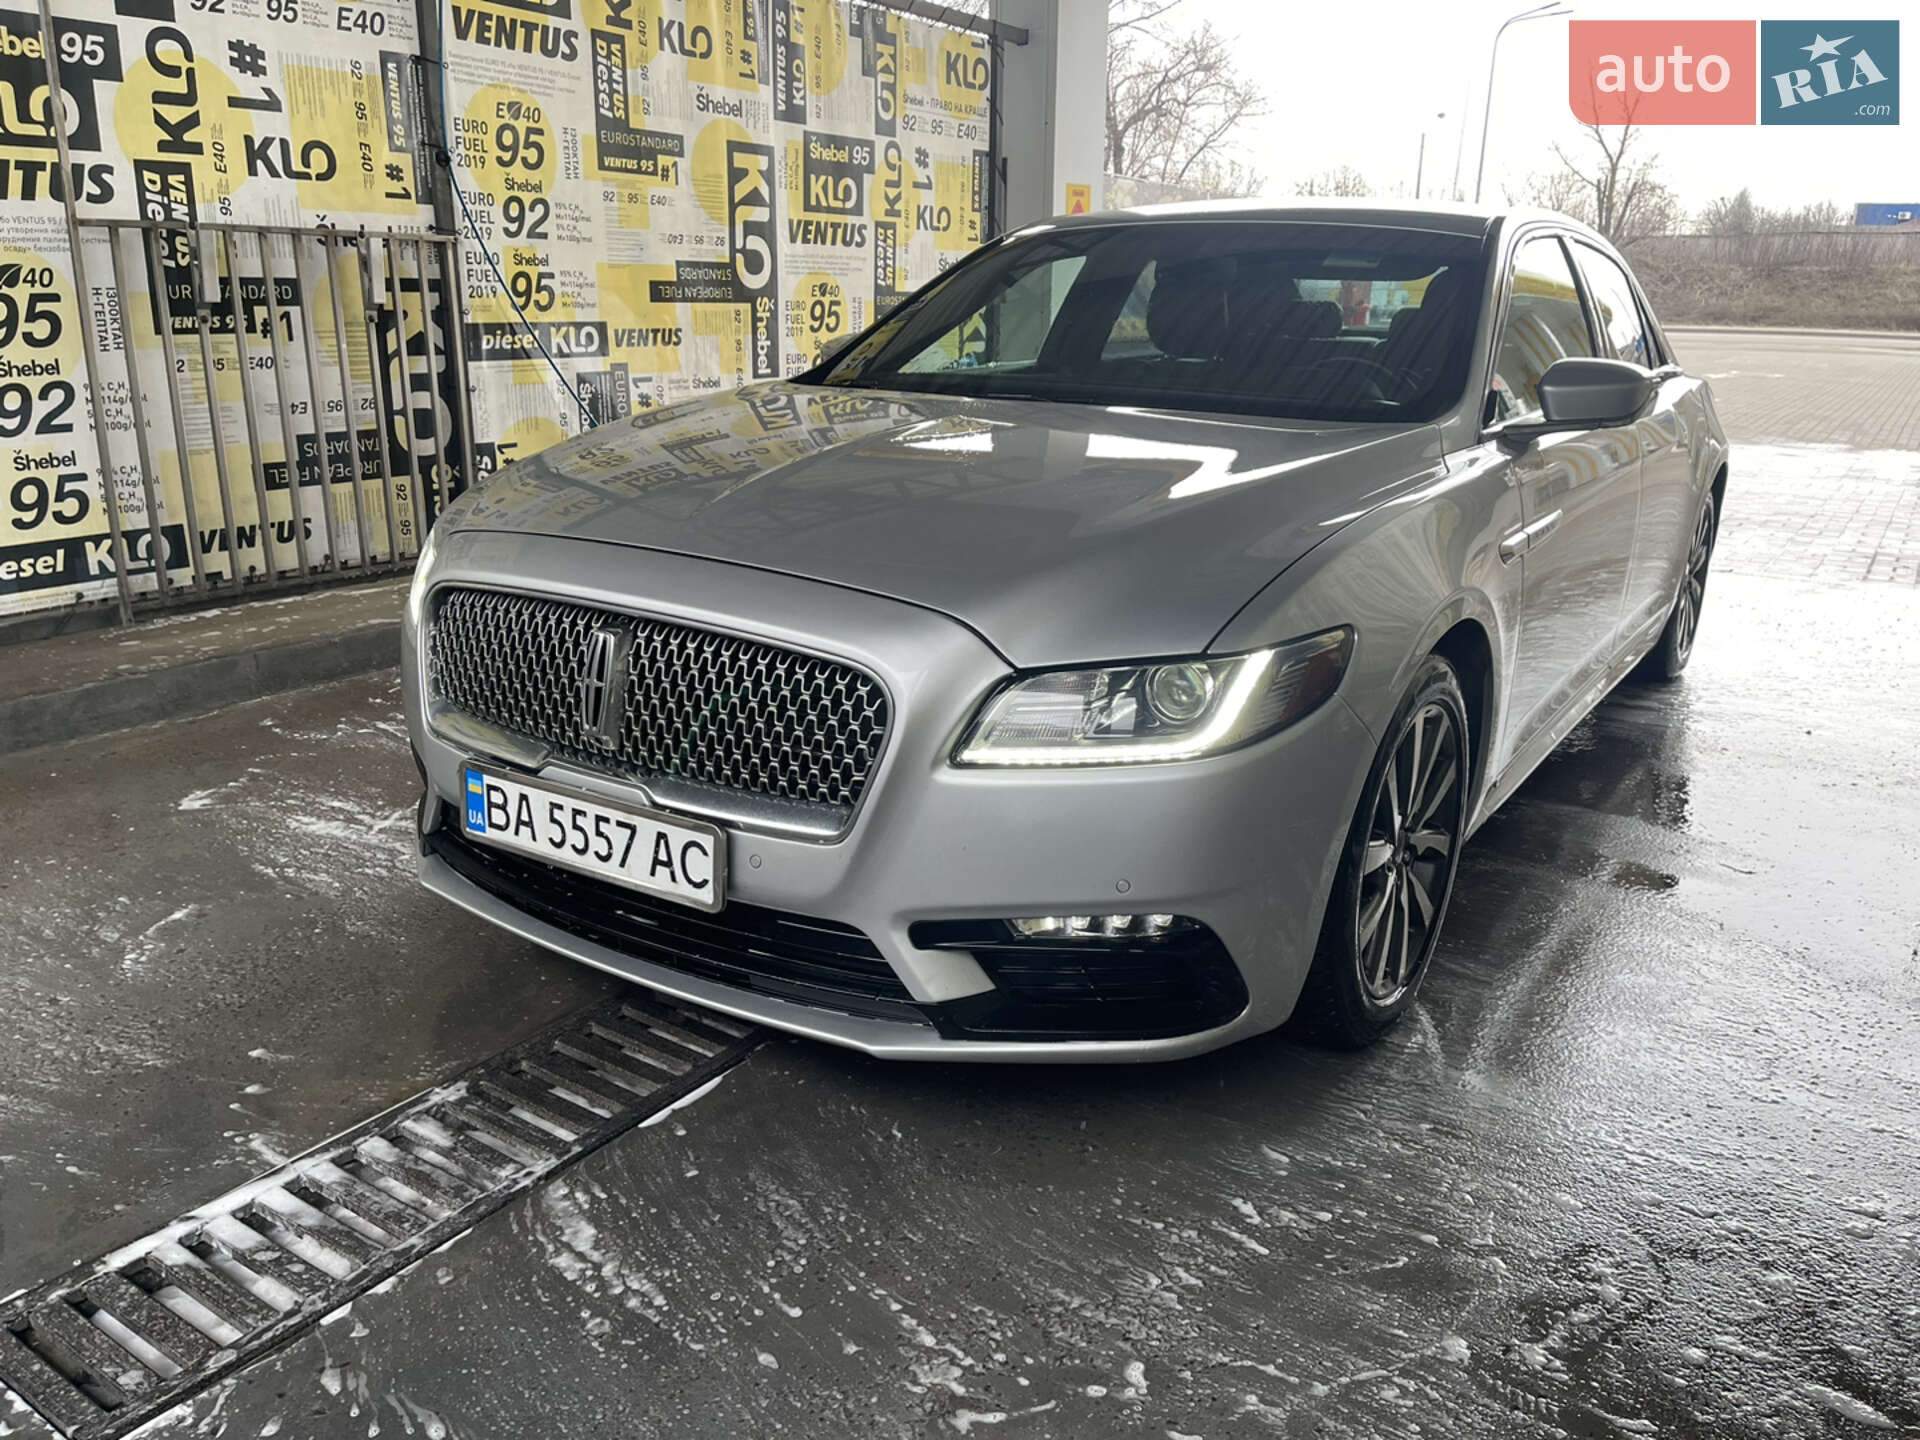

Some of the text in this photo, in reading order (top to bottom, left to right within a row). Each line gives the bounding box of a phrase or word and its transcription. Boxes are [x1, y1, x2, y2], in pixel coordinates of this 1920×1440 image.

[267, 0, 298, 23] 95
[336, 7, 385, 36] E40
[452, 5, 579, 62] VENTUS
[60, 32, 105, 66] 95
[658, 16, 713, 60] KLO
[596, 38, 613, 119] Diesel
[610, 43, 626, 121] VENTUS
[775, 44, 787, 111] VENTUS
[792, 59, 805, 106] KLO
[876, 43, 896, 121] KLO
[946, 50, 990, 91] KLO
[145, 26, 204, 155] KLO
[386, 62, 403, 115] VENTUS
[696, 85, 743, 118] Šhebel
[354, 101, 368, 121] 95
[453, 117, 489, 135] EURO
[212, 141, 228, 174] E40
[243, 134, 337, 182] KLO
[359, 142, 374, 172] E40
[455, 135, 488, 153] FUEL
[495, 123, 545, 171] 95
[601, 130, 680, 152] EUROSTANDARD
[809, 136, 870, 165] Šhebel 95
[456, 153, 486, 170] 2019
[603, 156, 638, 169] VENTUS
[640, 160, 655, 172] 95
[504, 172, 543, 193] Šhebel
[810, 174, 857, 208] KLO
[884, 140, 902, 218] KLO
[603, 191, 616, 202] 92
[627, 193, 639, 204] 95
[502, 195, 551, 240] 92
[733, 151, 772, 289] KLO
[789, 218, 867, 248] VENTUS
[916, 204, 951, 233] KLO
[513, 248, 549, 267] Šhebel
[510, 270, 556, 313] 95
[809, 300, 842, 333] 95
[551, 326, 600, 354] KLO
[614, 327, 683, 348] VENTUS
[756, 296, 775, 375] Šhebel
[0, 380, 76, 438] 92
[13, 450, 77, 472] Šhebel
[10, 472, 90, 530] 95
[468, 810, 484, 826] UA
[485, 784, 710, 889] BA 5557 AC
